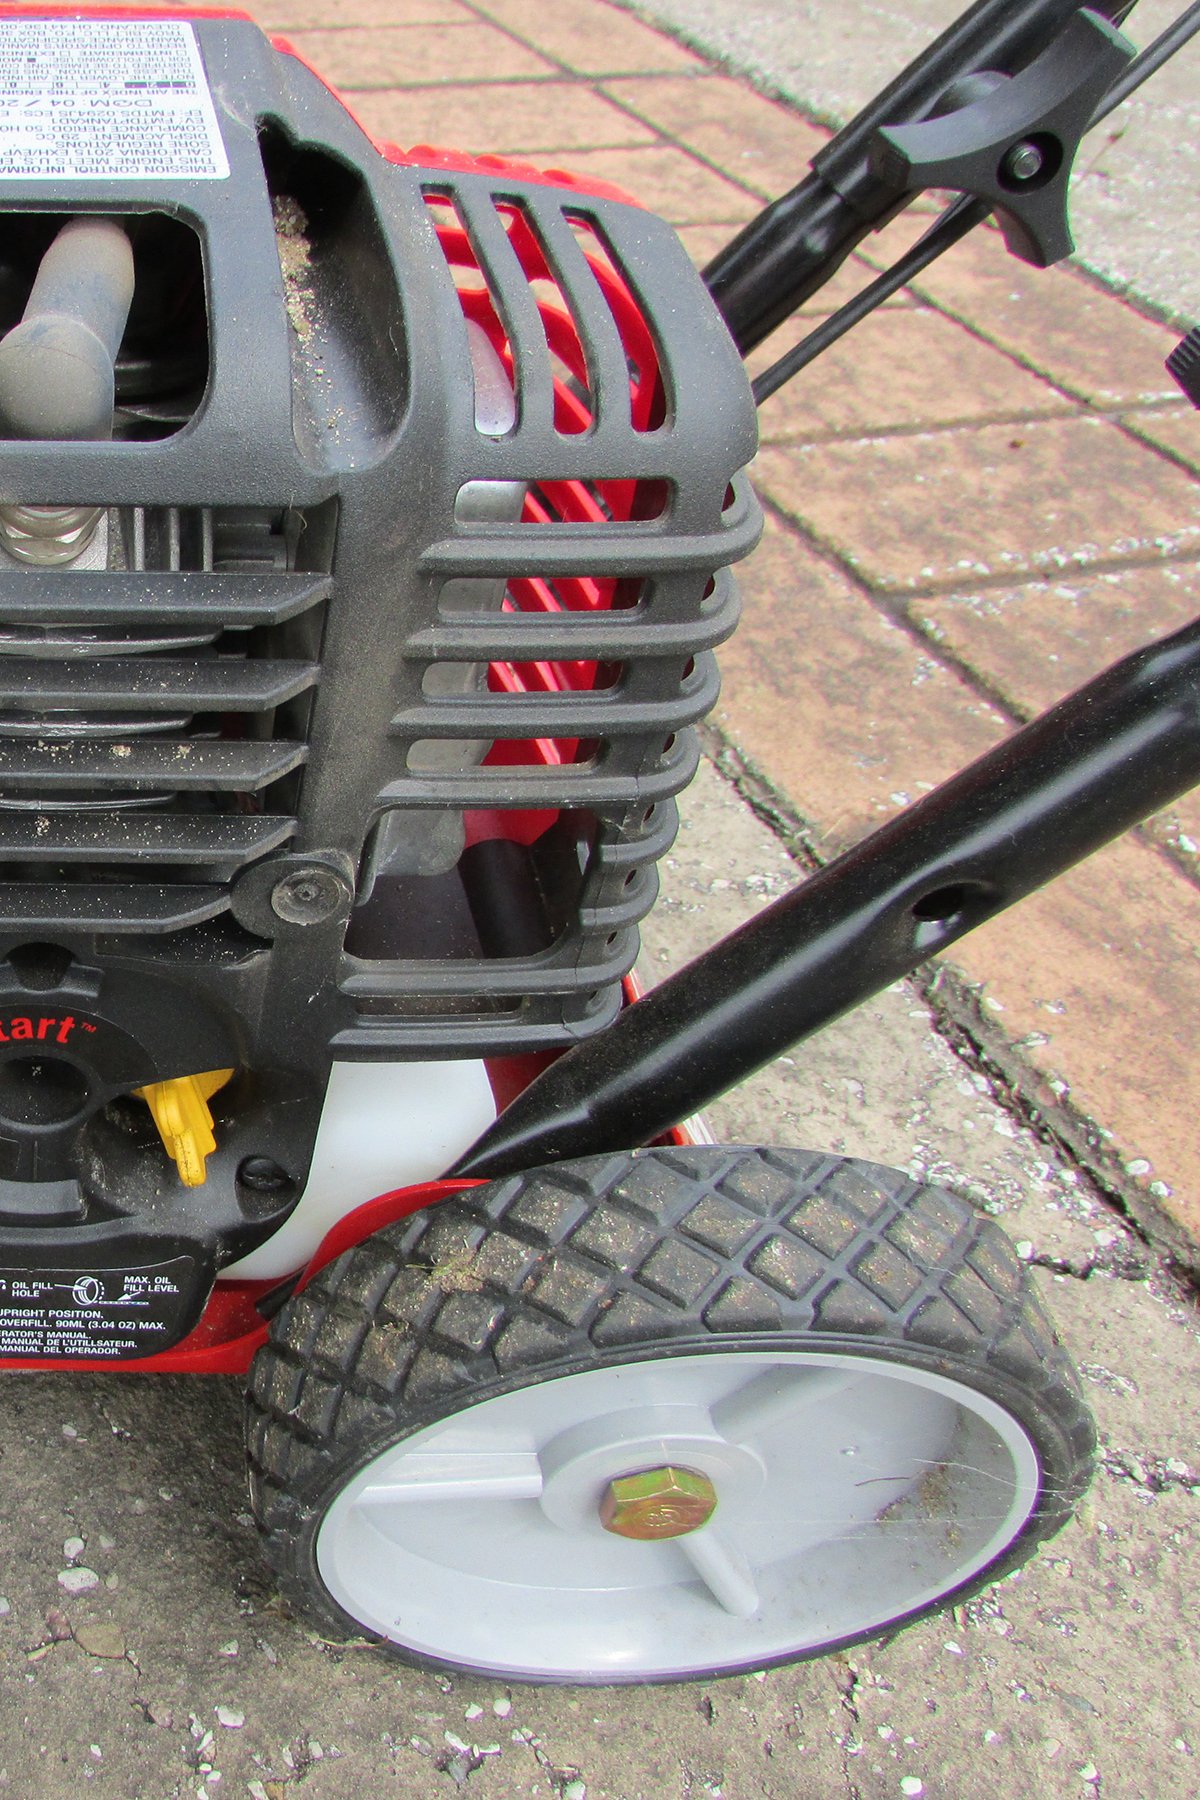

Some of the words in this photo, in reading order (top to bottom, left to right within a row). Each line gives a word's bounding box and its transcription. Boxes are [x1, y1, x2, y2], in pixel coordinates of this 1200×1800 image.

[50, 99, 75, 107] 04
[55, 157, 109, 165] MEETS
[115, 157, 173, 165] ENGINE
[179, 157, 212, 165] THIS
[70, 165, 139, 174] CONTROL
[144, 165, 216, 174] EMISSION
[124, 1276, 151, 1284] MAX.
[154, 1276, 171, 1284] OIL
[12, 1281, 29, 1290] OIL
[32, 1281, 53, 1290] FILL
[123, 1284, 145, 1292] FILL
[147, 1285, 179, 1293] LEVEL
[11, 1290, 40, 1298] HOLE
[48, 1309, 104, 1319] POSITION.
[0, 1318, 52, 1328] OVERFILL.
[56, 1319, 85, 1328] 90ML
[88, 1320, 115, 1330] (3.04
[139, 1321, 166, 1330] MAX.
[47, 1331, 91, 1339] MANUAL.
[1, 1337, 43, 1346] MANUAL
[46, 1339, 60, 1347] DE
[43, 1346, 61, 1354] DEL
[64, 1347, 121, 1355] OPERADOR.
